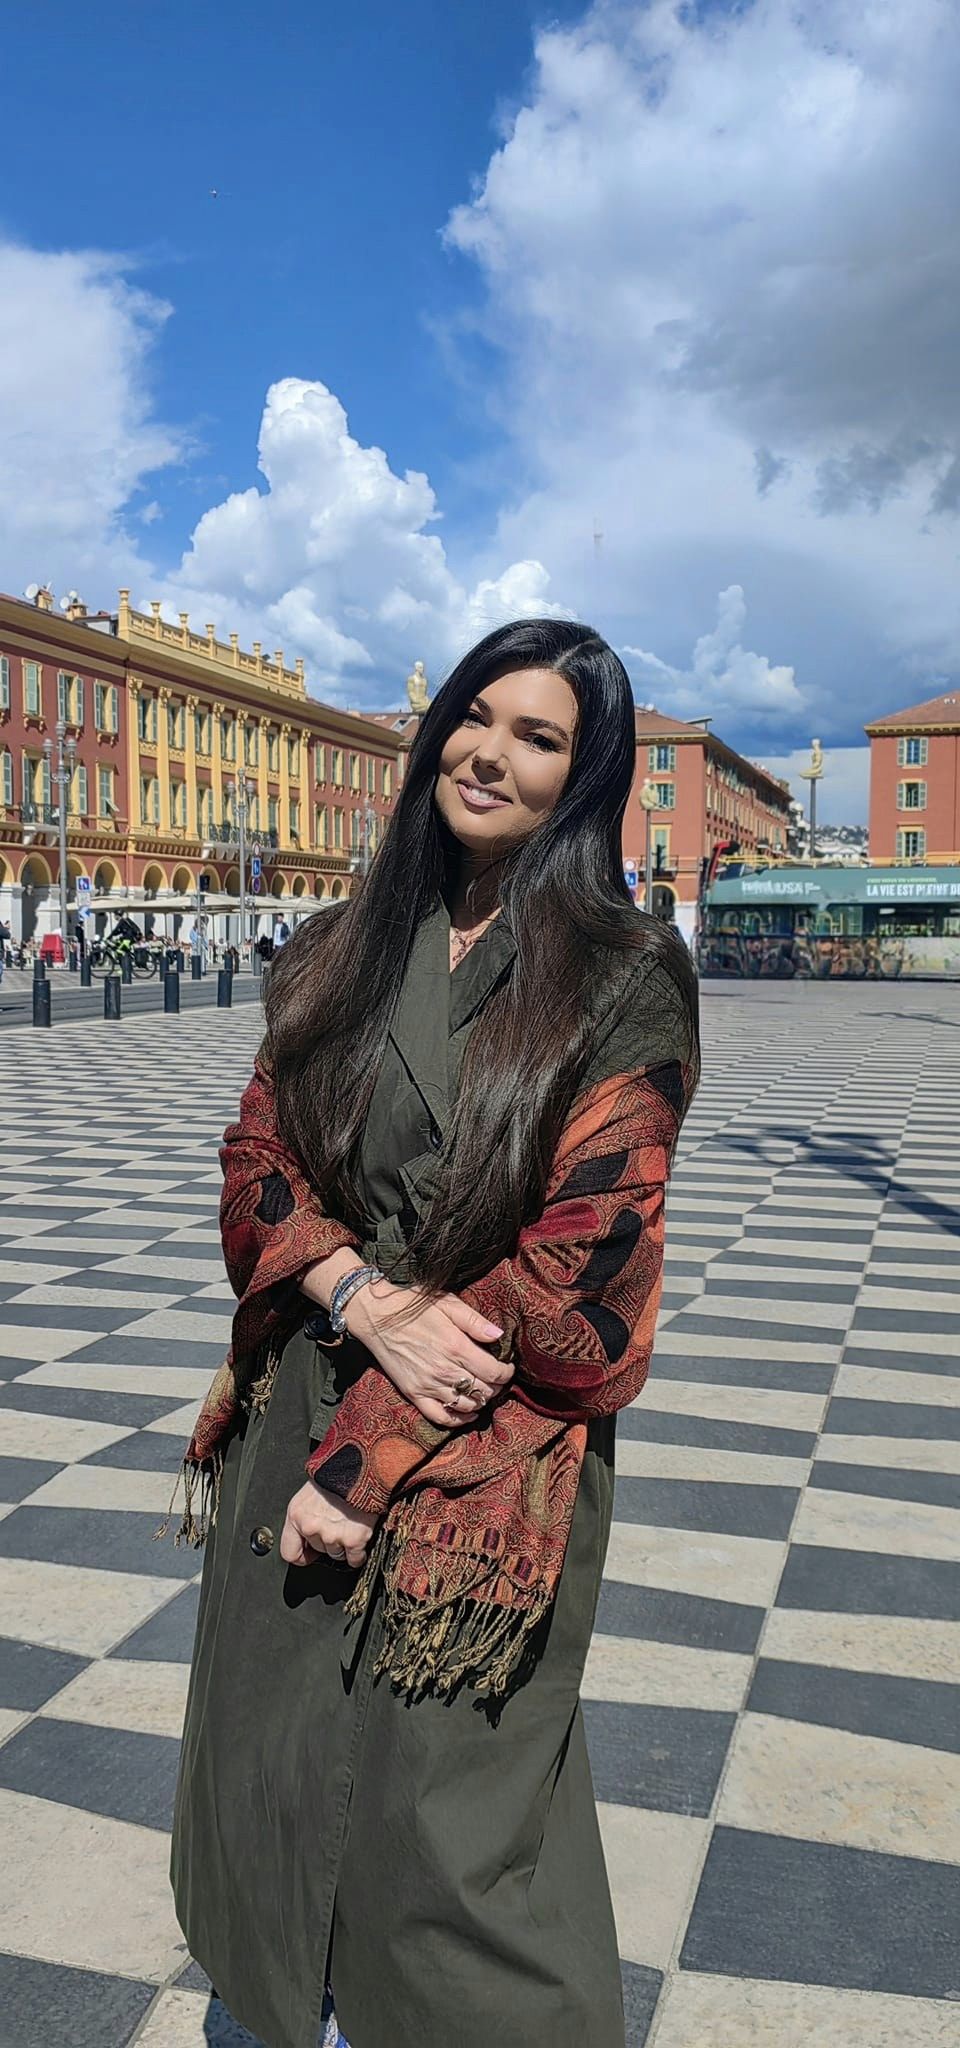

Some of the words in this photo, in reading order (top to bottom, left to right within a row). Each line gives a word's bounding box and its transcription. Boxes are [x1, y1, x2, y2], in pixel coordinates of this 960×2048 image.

[867, 884, 879, 896] LA
[880, 884, 895, 896] VIE
[897, 884, 914, 896] EST
